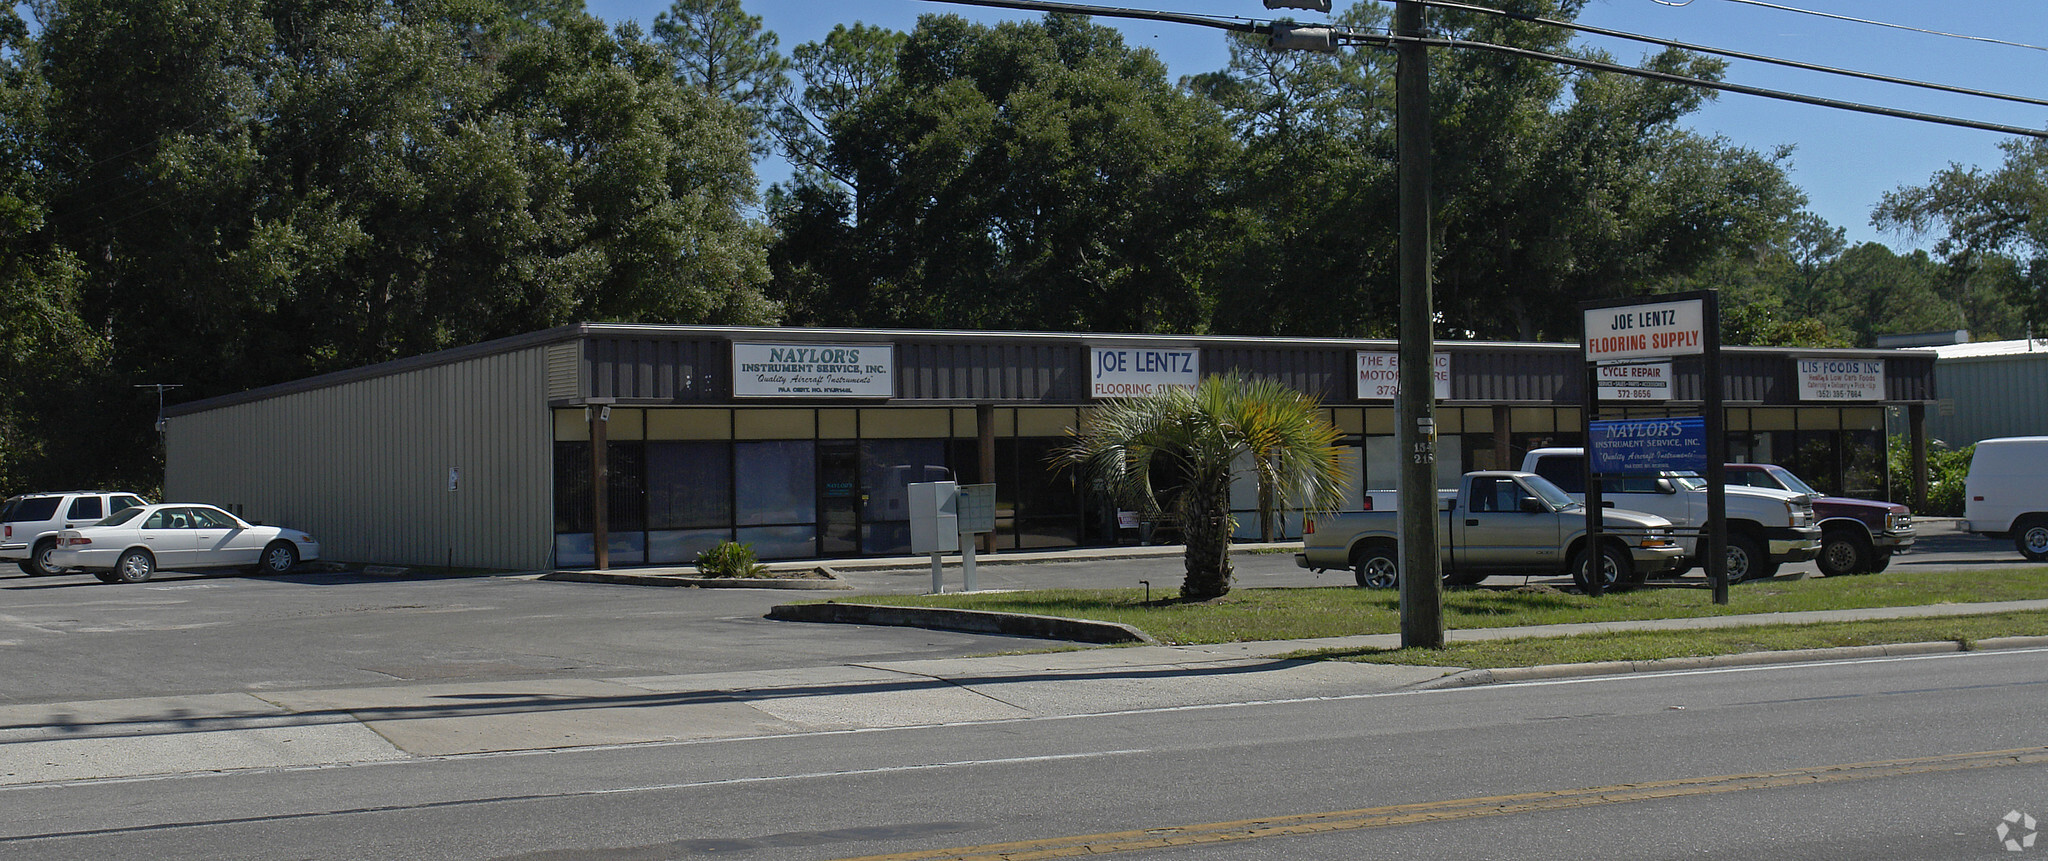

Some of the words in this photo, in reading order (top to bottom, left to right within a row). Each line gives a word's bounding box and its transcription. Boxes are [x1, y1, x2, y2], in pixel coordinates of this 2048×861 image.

[1611, 313, 1633, 330] JOE
[1639, 309, 1675, 328] LENTZ
[1589, 334, 1646, 353] FLOORING
[1652, 330, 1699, 349] SUPPLY
[769, 348, 860, 364] NAYLOR'S
[1360, 356, 1383, 366] THE
[741, 363, 813, 373] INSTRUMENT
[816, 364, 863, 375] SERVICE,
[866, 365, 887, 374] INC.
[1096, 351, 1127, 379] JOE
[1136, 352, 1193, 373] LENTZ
[1863, 362, 1880, 374] INC
[1602, 367, 1628, 377] CYCLE
[1631, 367, 1661, 377] REPAIR
[789, 374, 824, 385] Aircraft
[1095, 383, 1152, 395] FLOORING
[1617, 389, 1651, 398] 372-8656
[1606, 420, 1682, 438] NAYLOR'S
[1595, 440, 1644, 448] INSTRUMENT
[1684, 438, 1701, 446] INC.
[1628, 452, 1654, 461] Aircraft
